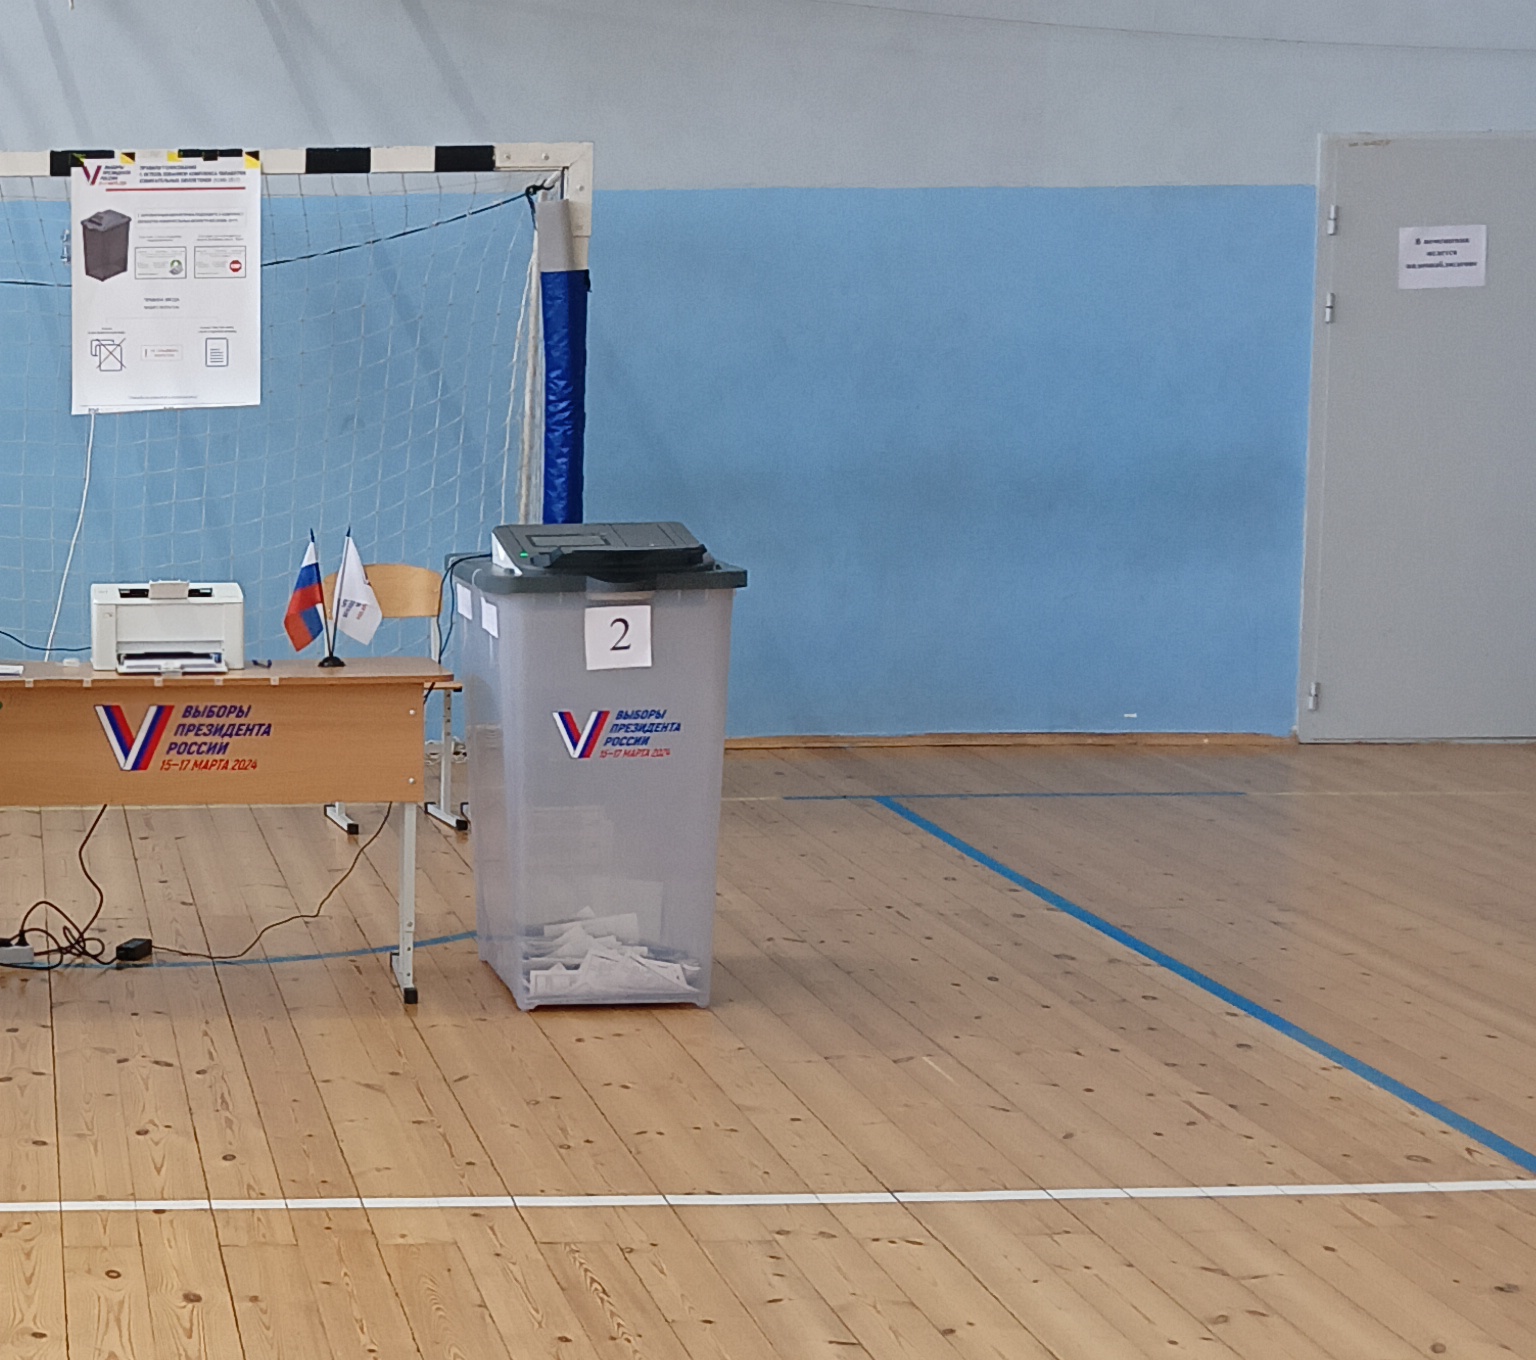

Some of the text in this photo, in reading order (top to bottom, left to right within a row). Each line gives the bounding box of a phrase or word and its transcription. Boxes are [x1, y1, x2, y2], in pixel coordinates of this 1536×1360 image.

[610, 618, 631, 651] 2
[182, 705, 252, 718] ВЫБОРЫ
[615, 709, 667, 720] ВЫБОРЫ
[173, 723, 272, 738] ПРЕЗИДЕНТА
[609, 722, 681, 734] ПРЕЗИДЕНТА
[603, 736, 650, 746] РОССИИ
[166, 742, 230, 755] РОССИИ
[622, 748, 650, 758] МАРТА
[192, 759, 228, 771] МАРТА
[231, 758, 258, 771] 2024
